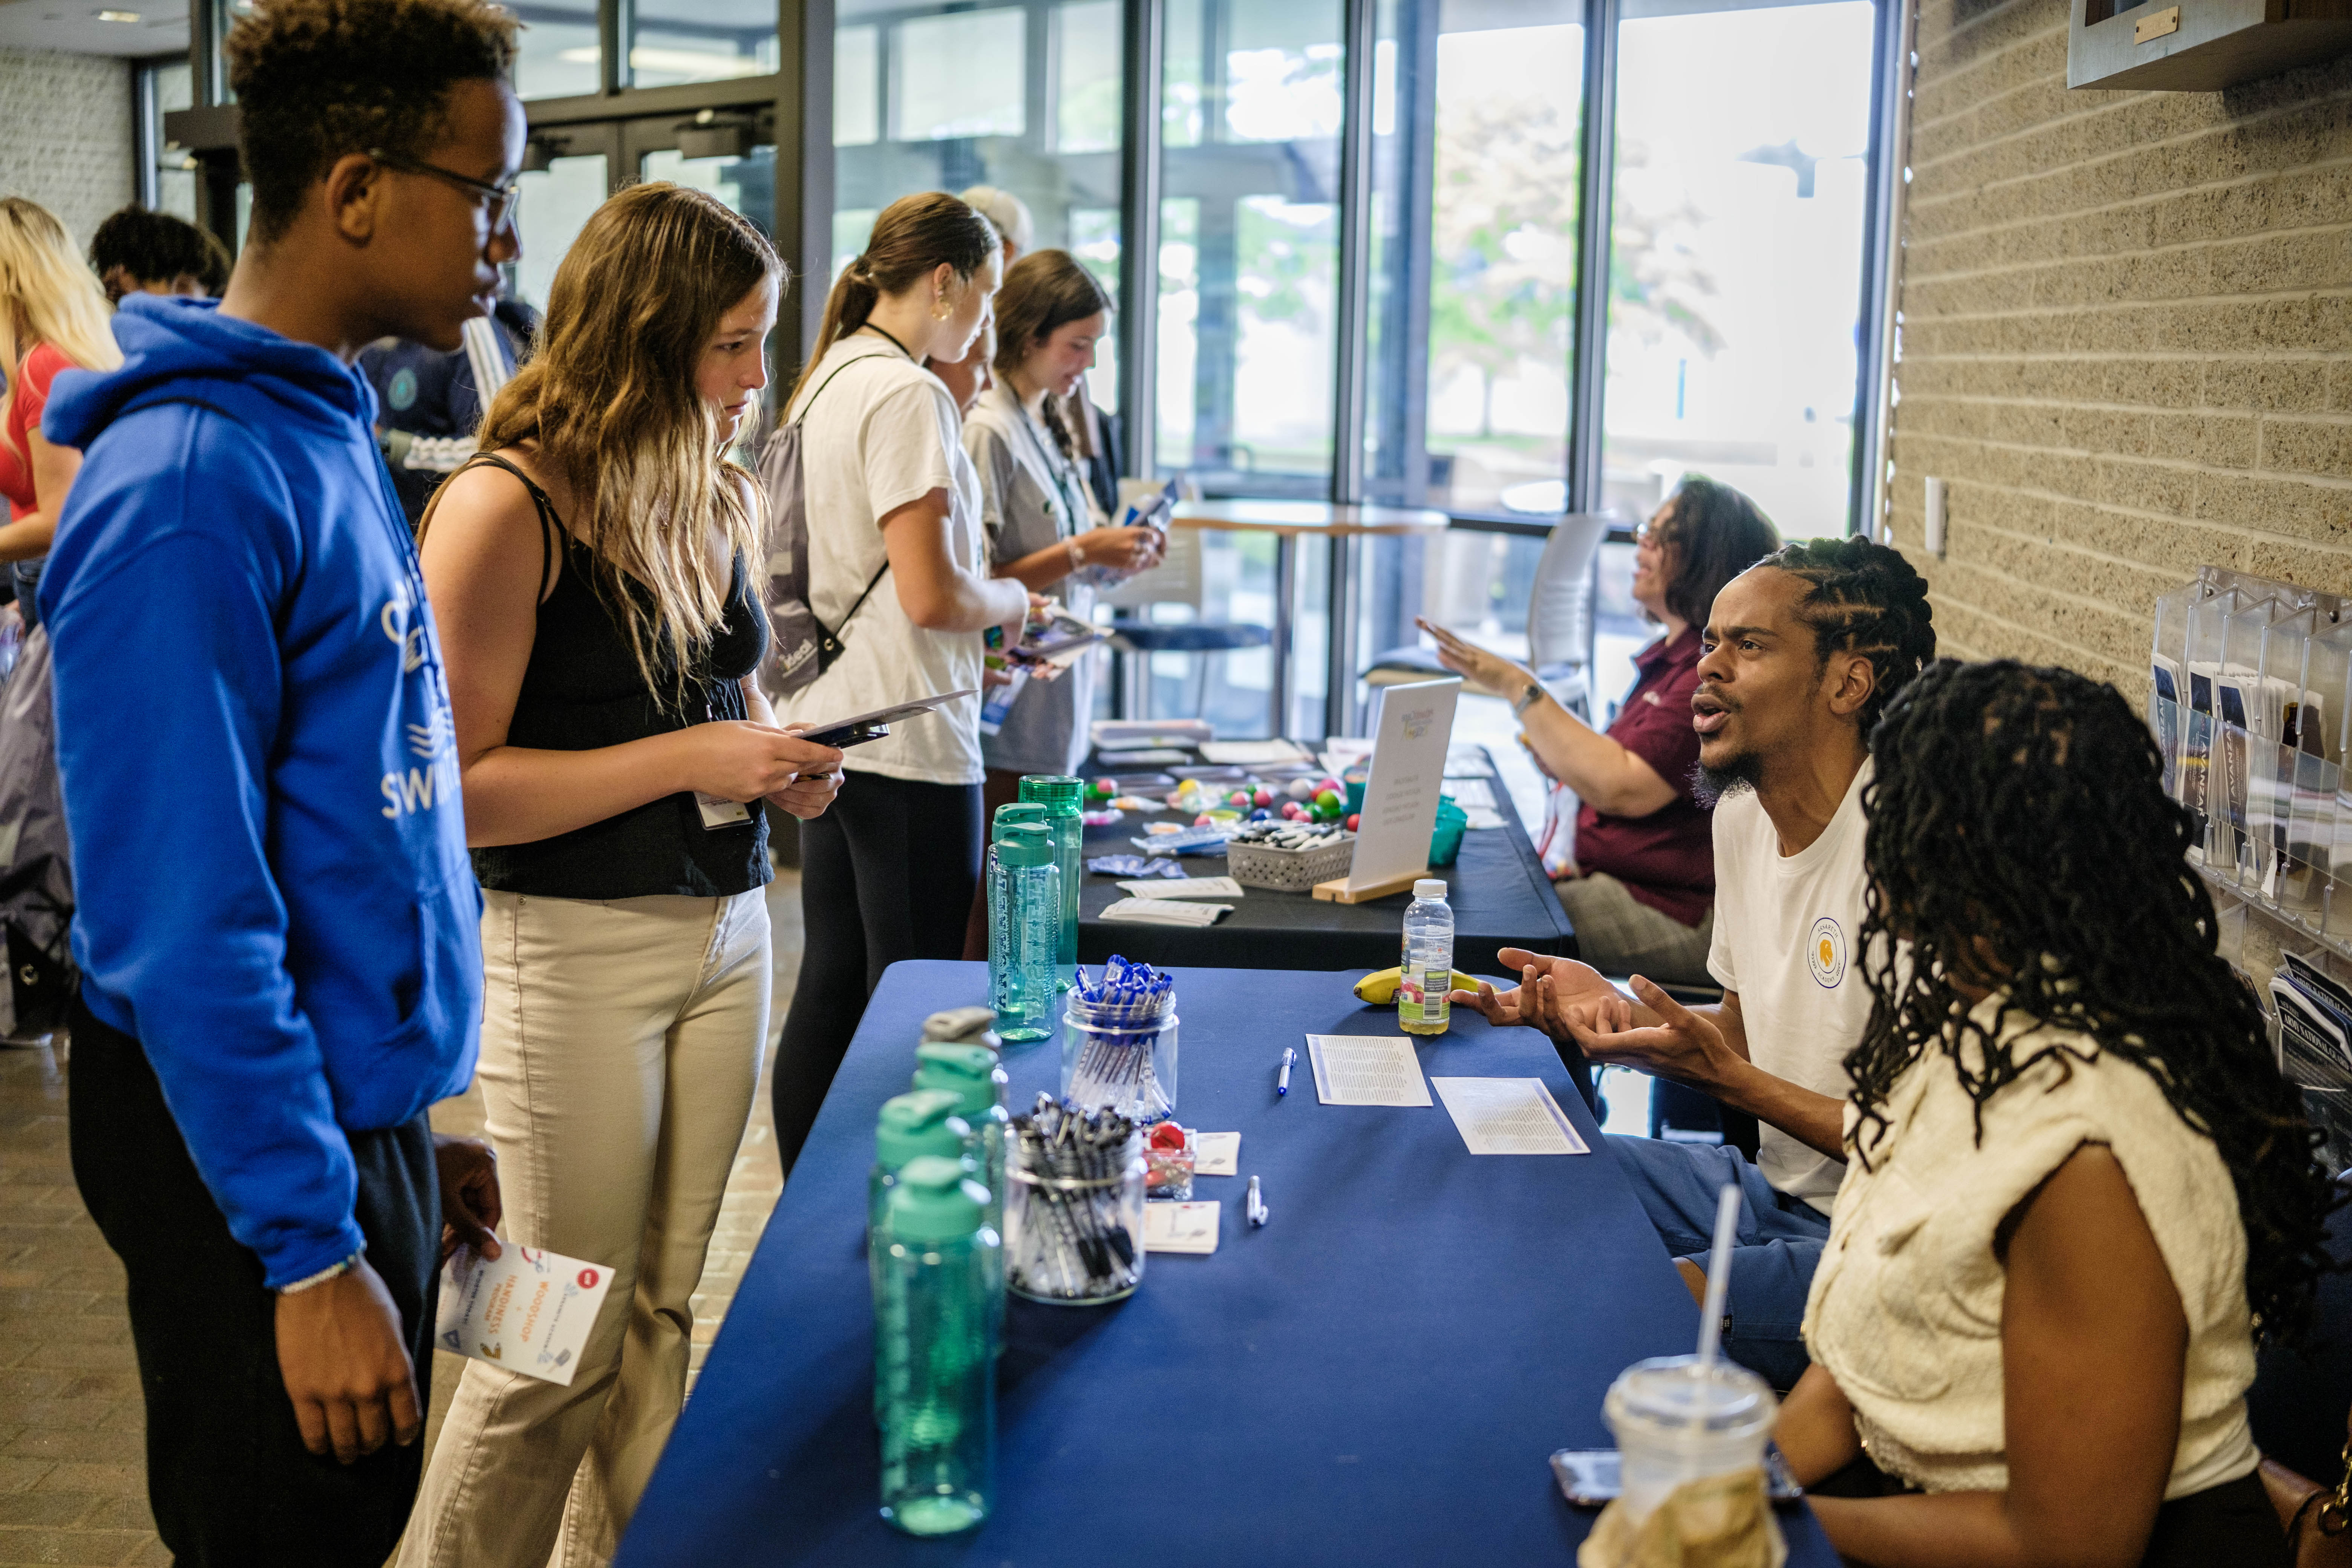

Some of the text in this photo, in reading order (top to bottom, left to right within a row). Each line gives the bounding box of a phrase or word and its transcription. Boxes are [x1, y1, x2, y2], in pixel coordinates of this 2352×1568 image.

[2198, 741, 2207, 817] AVANZAR
[2225, 720, 2235, 797] AVANZAR
[1818, 924, 1838, 938] ARSARETH
[1818, 972, 1835, 983] ACADEMY
[2285, 1014, 2299, 1032] ARMY
[2300, 1025, 2329, 1054] NATIONAL
[488, 1274, 518, 1334] HANDINESS
[519, 1281, 549, 1342] WOODSHOP
